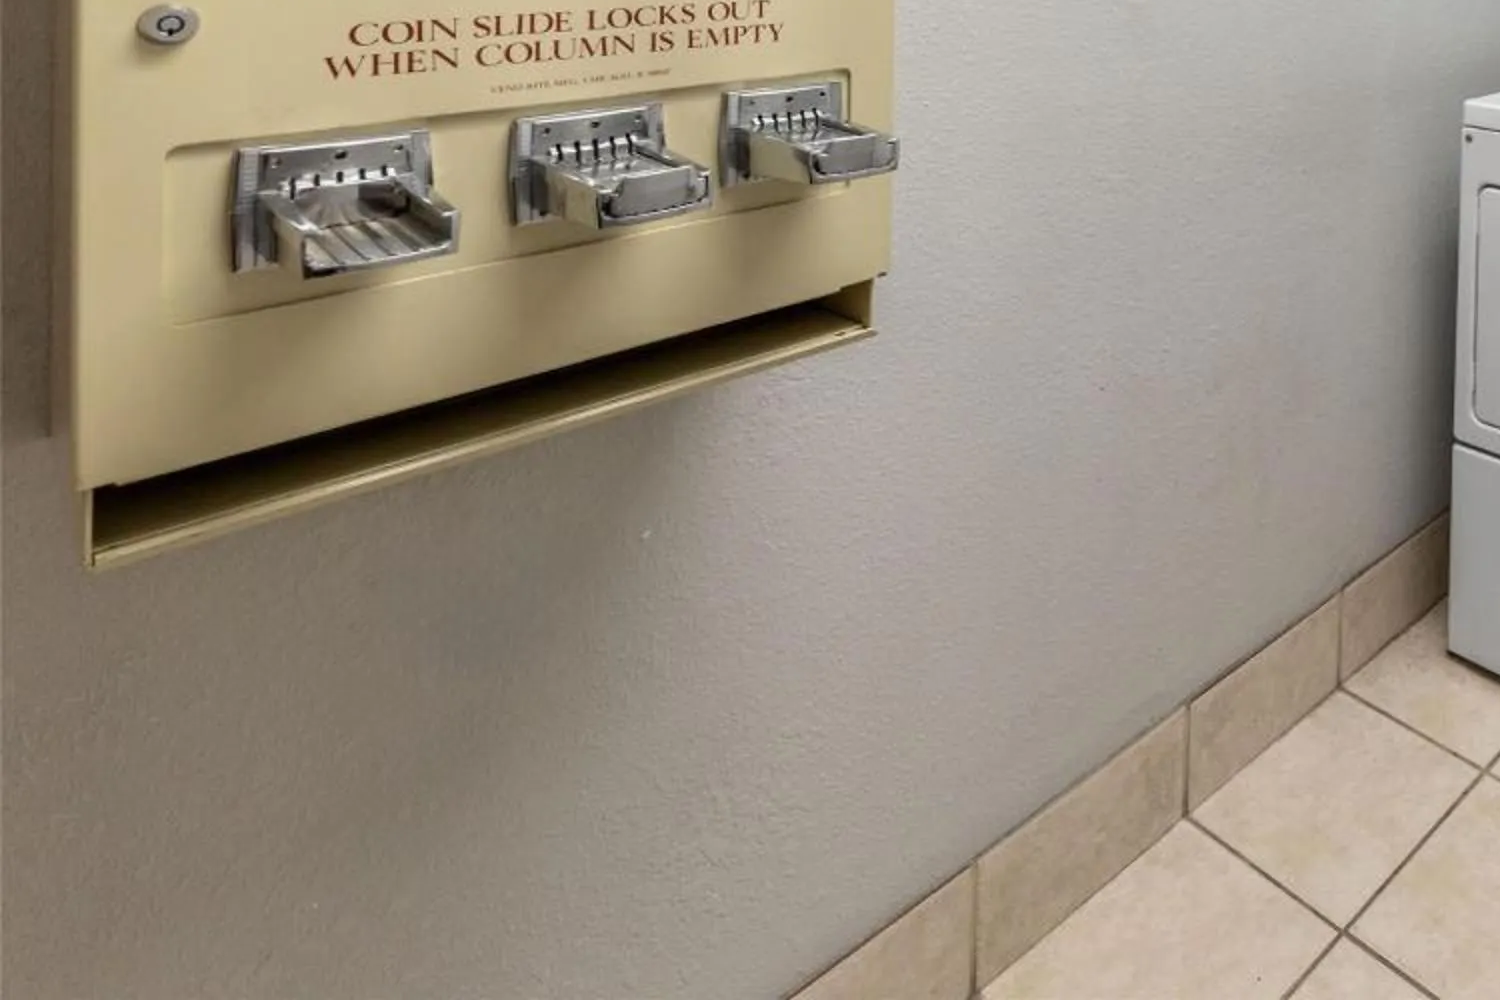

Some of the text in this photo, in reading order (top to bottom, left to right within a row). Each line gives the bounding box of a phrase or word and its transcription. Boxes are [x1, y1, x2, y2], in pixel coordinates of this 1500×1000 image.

[349, 0, 770, 46] COIN SLIDE LOCKS OUT
[324, 22, 784, 79] WHEN COLUMN IS EMPTY
